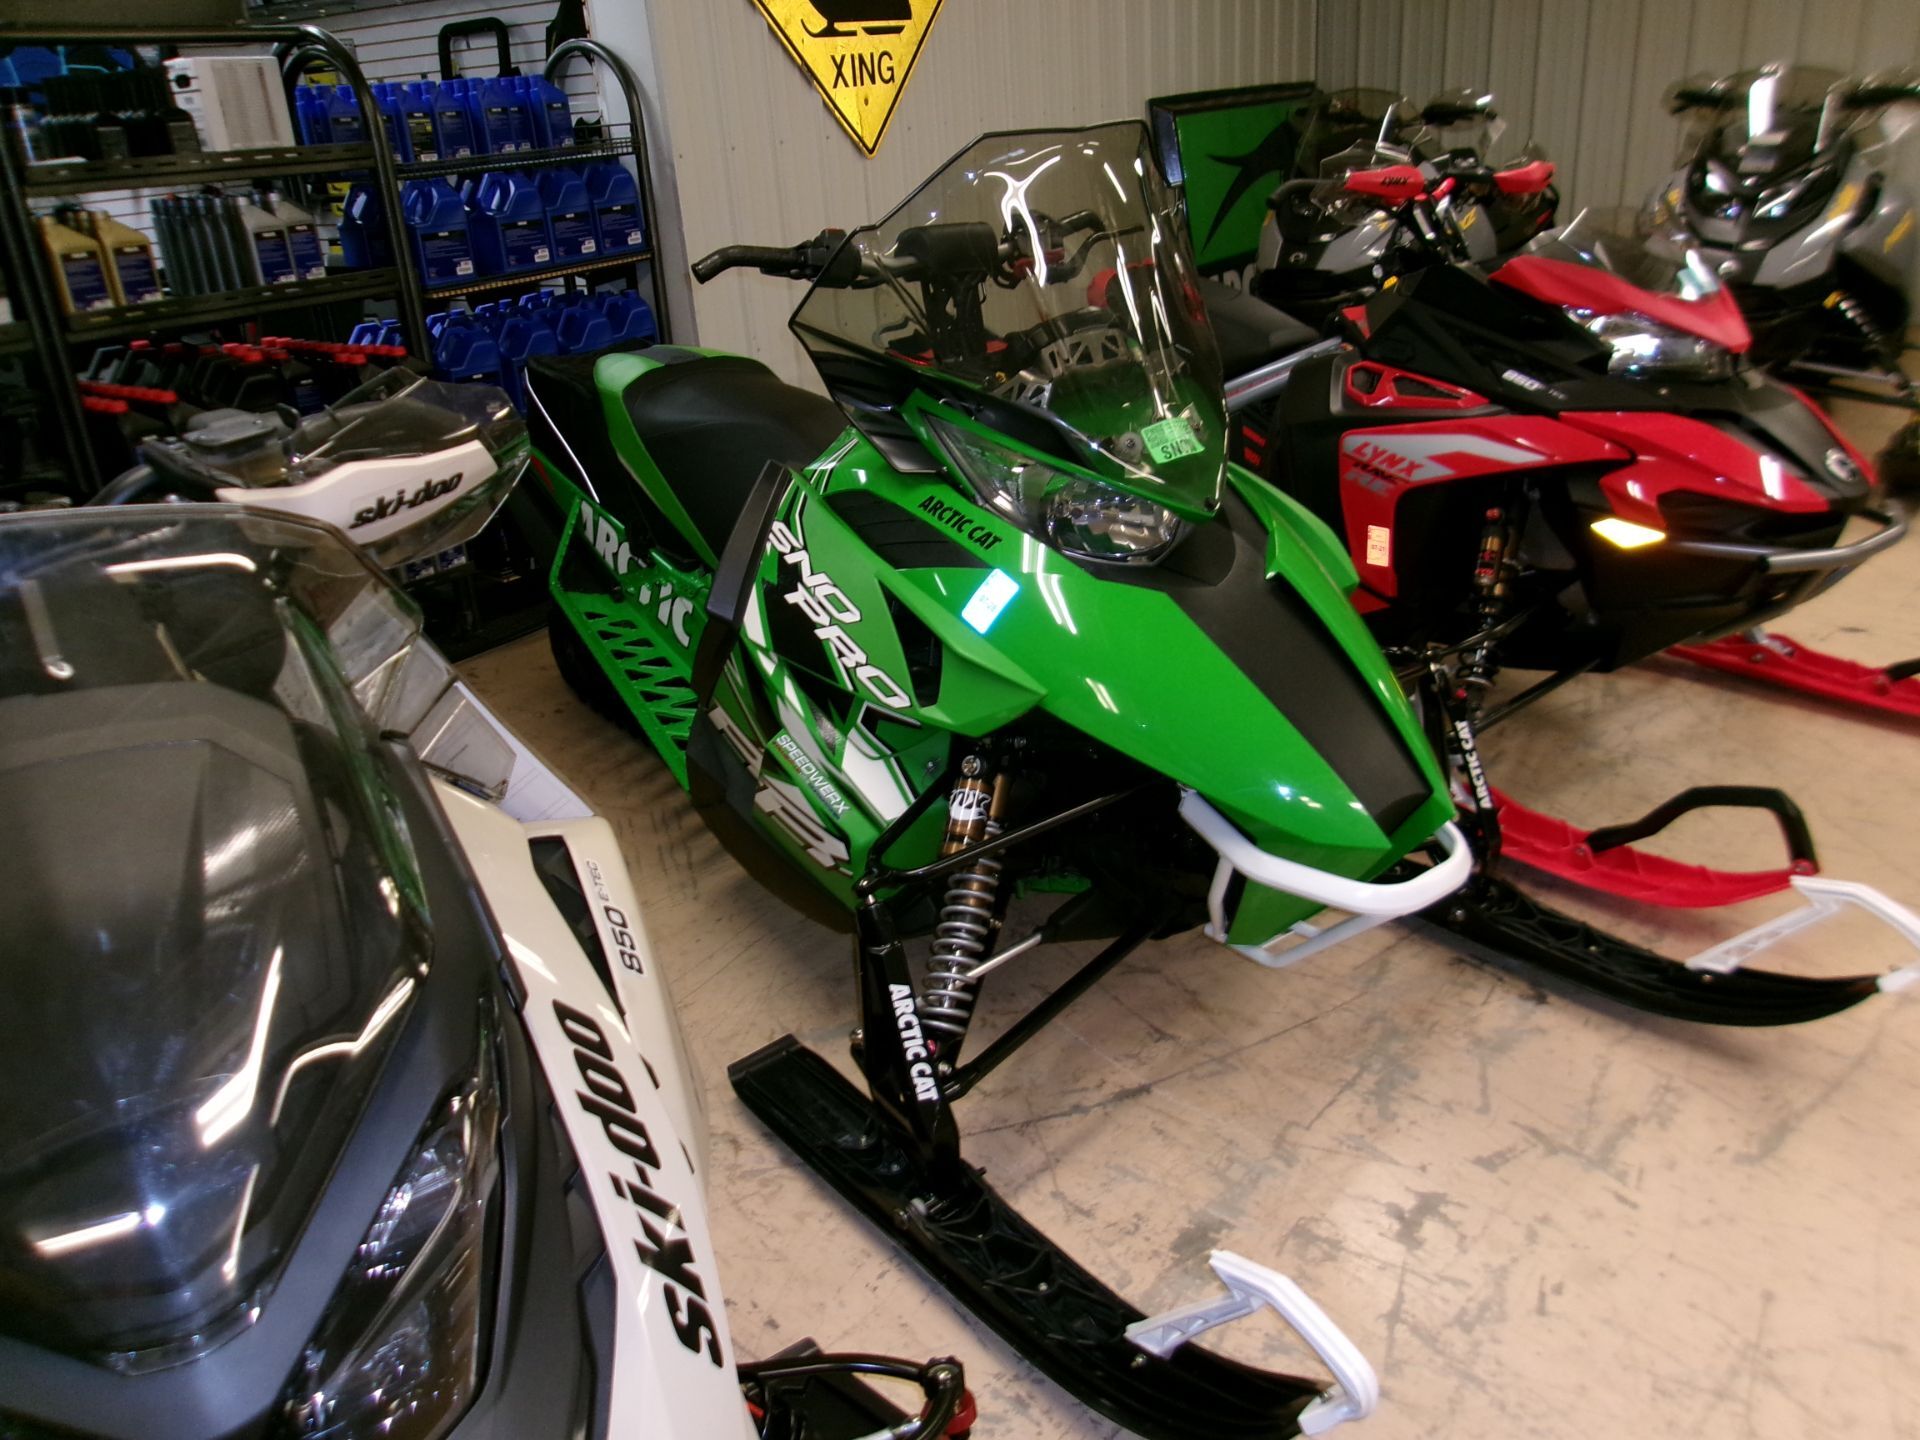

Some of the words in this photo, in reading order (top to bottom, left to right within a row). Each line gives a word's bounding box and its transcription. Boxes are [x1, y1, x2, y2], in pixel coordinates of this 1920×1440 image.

[830, 50, 895, 89] XING
[1352, 441, 1424, 480] LYNX
[348, 472, 463, 529] ski-doo
[917, 494, 974, 534] ARCTIC
[967, 525, 1003, 550] CAT
[766, 520, 862, 624] SNO
[783, 581, 912, 709] PRO
[1454, 720, 1474, 752] CAT
[776, 734, 851, 814] SPEEDWERX
[1465, 751, 1493, 809] ARCTIC
[603, 905, 644, 975] 850
[888, 983, 928, 1061] ARCTIC
[910, 1061, 939, 1102] CAT
[552, 998, 724, 1369] ski-doo
